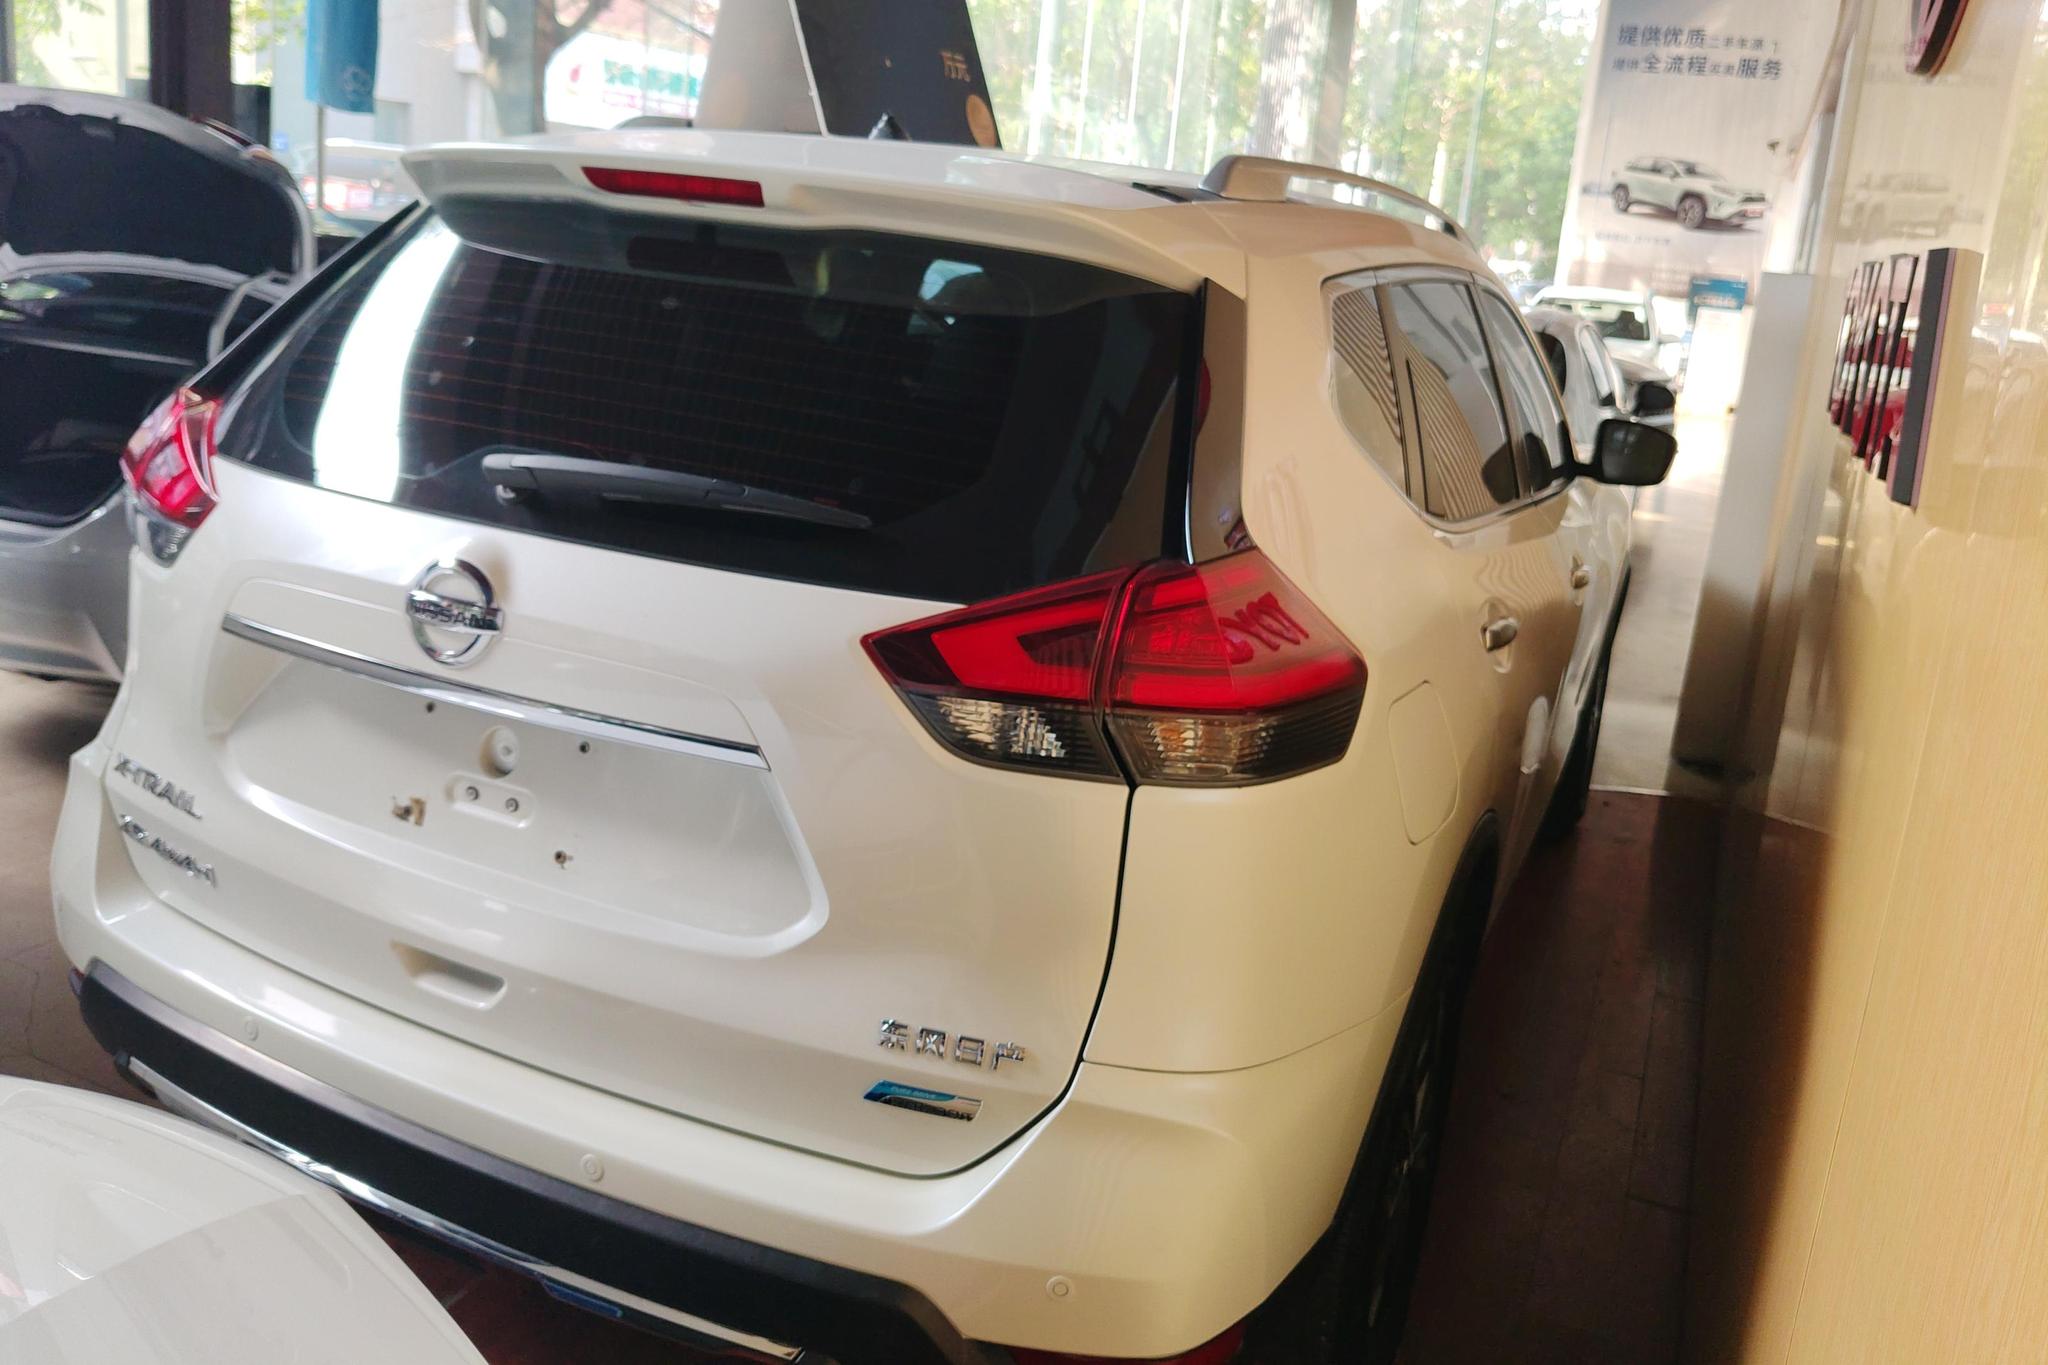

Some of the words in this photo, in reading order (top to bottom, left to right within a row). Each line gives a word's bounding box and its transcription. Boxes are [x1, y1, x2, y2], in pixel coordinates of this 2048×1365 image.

[113, 752, 203, 820] X-TRAIL
[878, 1018, 1026, 1071] 东风日产
